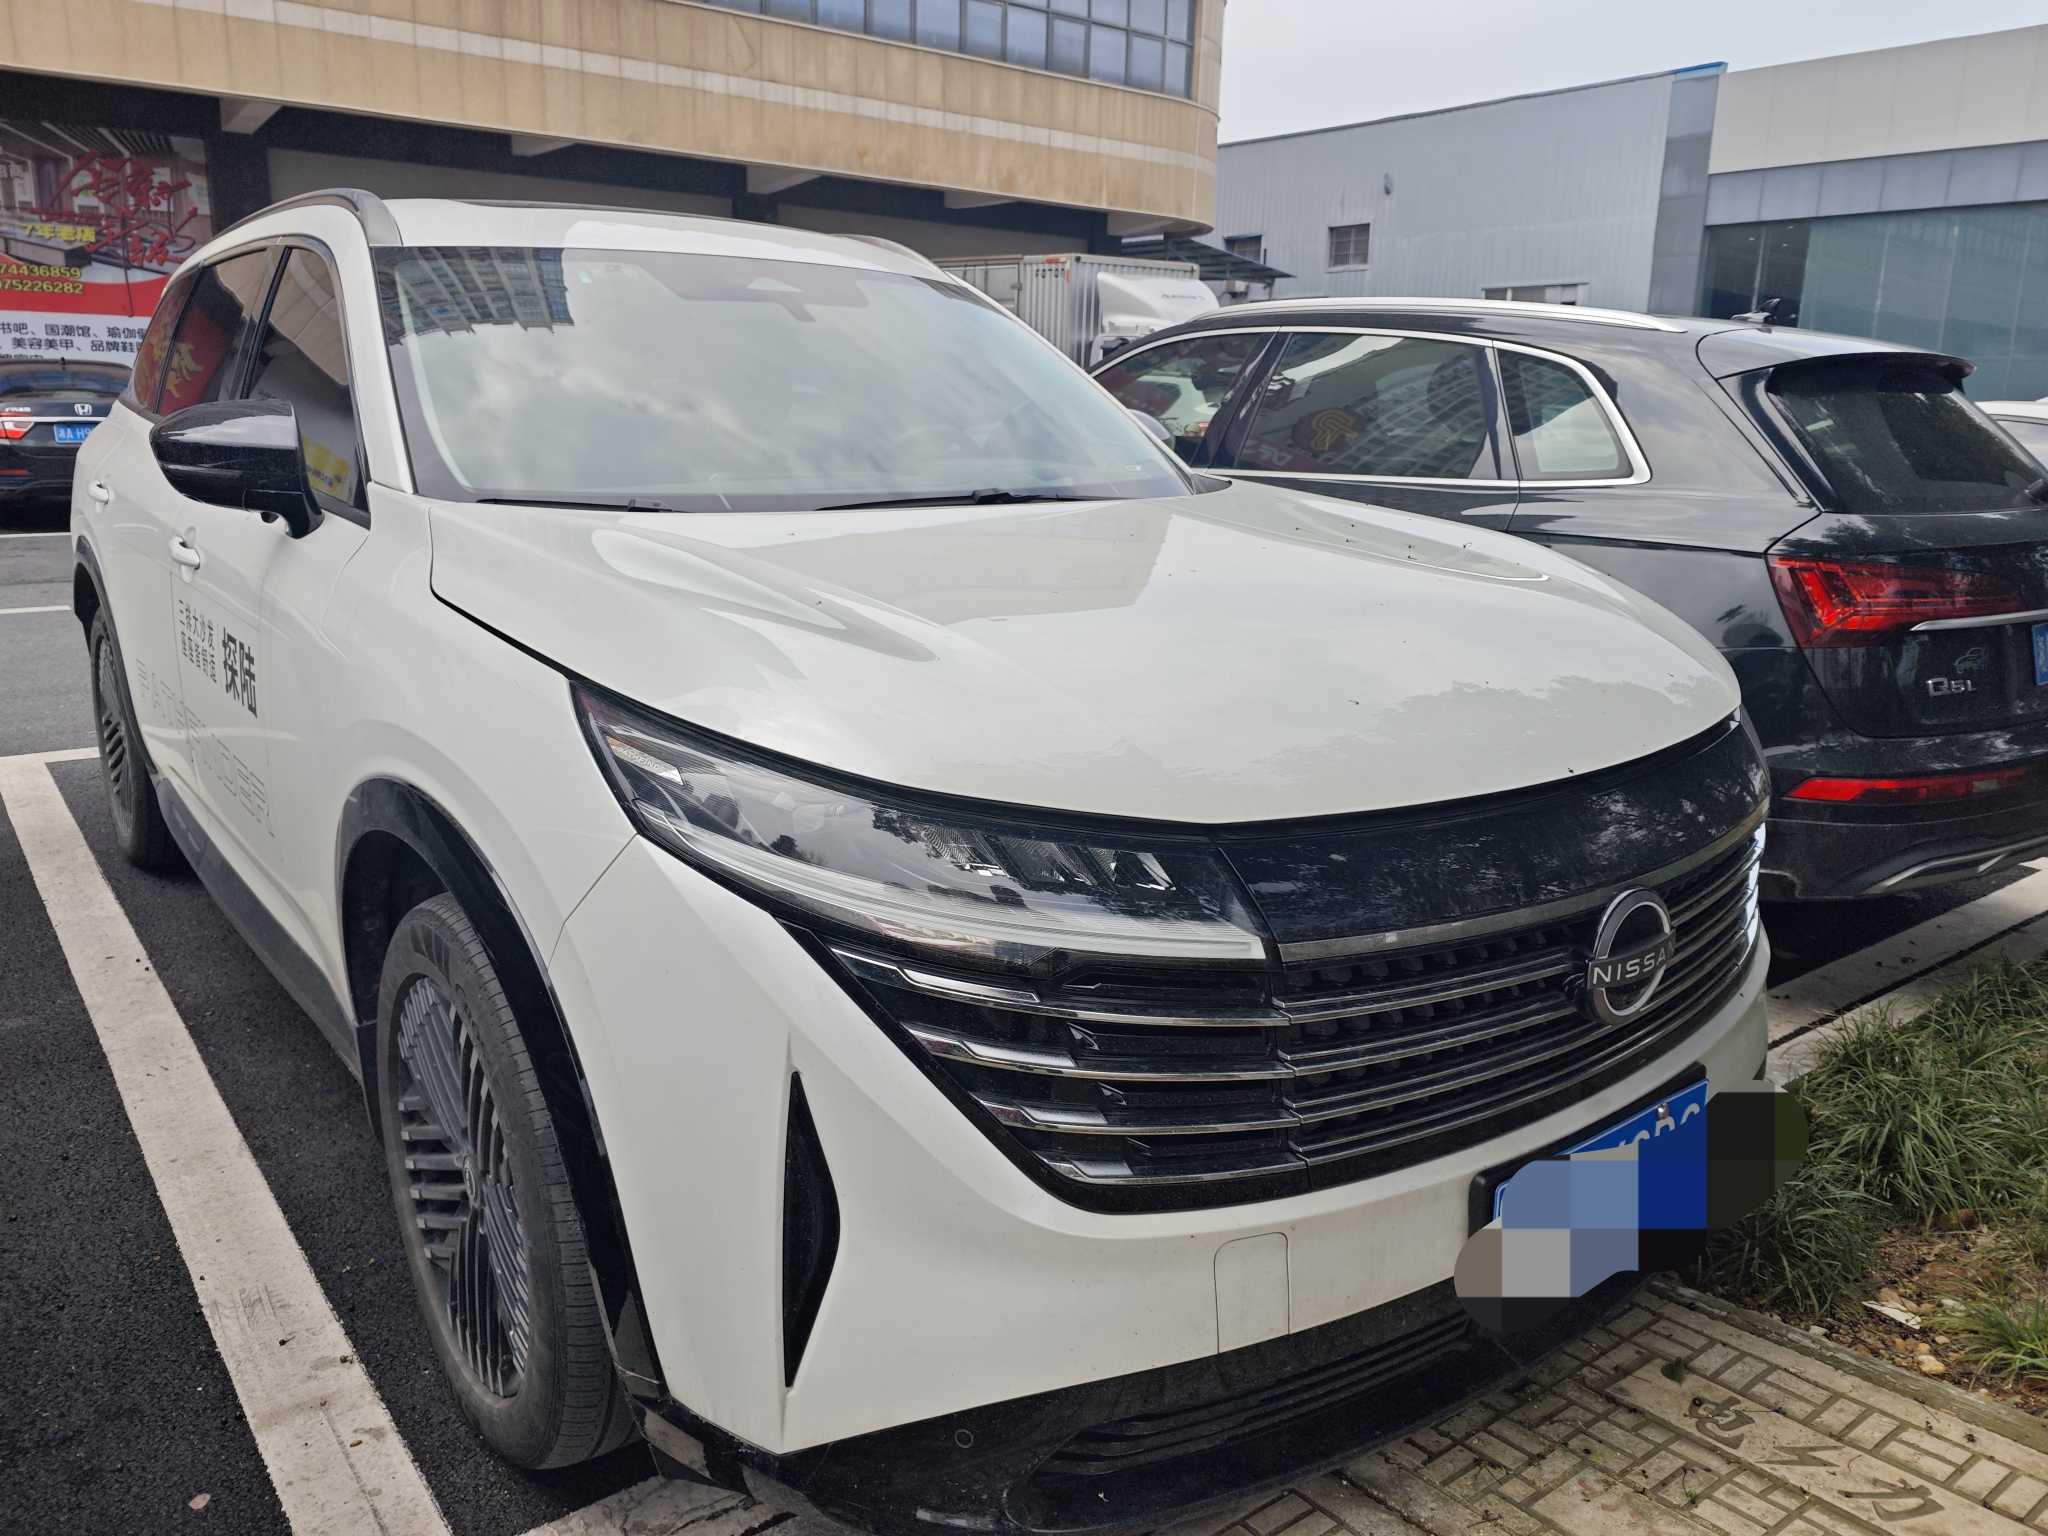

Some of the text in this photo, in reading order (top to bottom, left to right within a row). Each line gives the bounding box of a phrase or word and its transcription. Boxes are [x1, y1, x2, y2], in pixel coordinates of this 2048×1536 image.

[11, 336, 141, 354] 美容美甲、品牌鞋
[221, 626, 258, 719] 探陆
